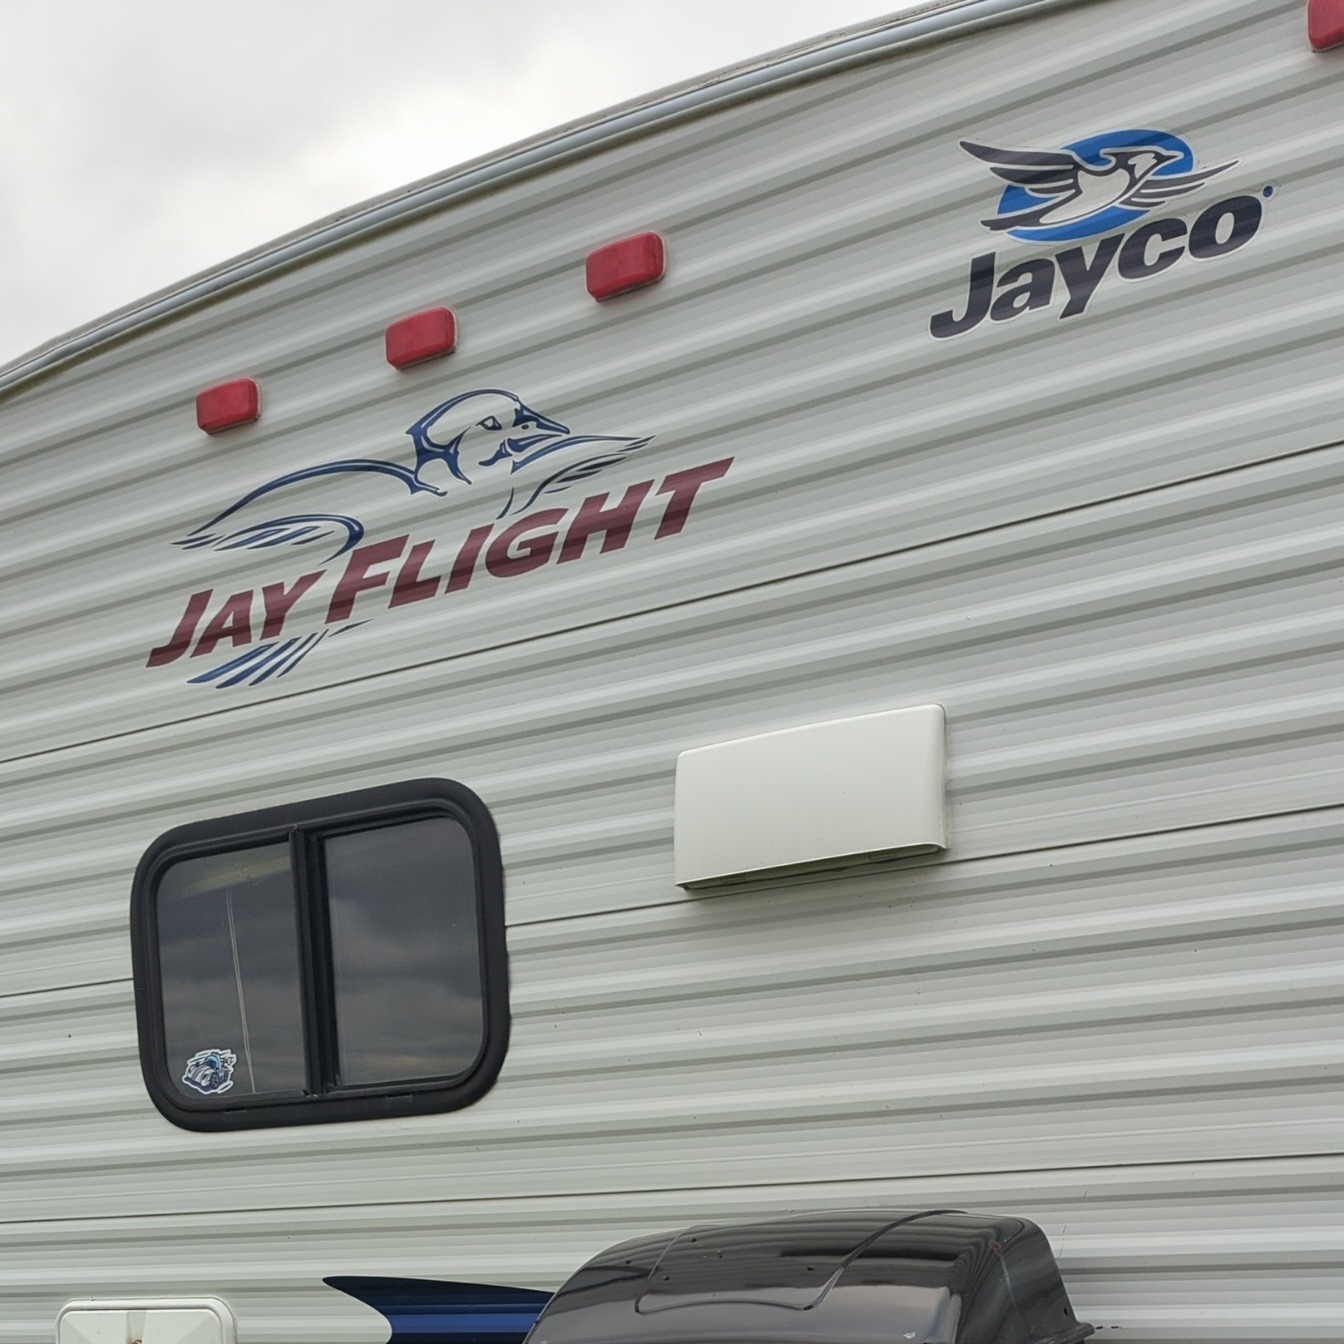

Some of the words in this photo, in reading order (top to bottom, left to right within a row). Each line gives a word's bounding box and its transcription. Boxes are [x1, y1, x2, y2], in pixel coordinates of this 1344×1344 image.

[929, 194, 1263, 339] Jayco
[145, 569, 325, 668] JAY
[324, 456, 734, 624] FLIGHT
